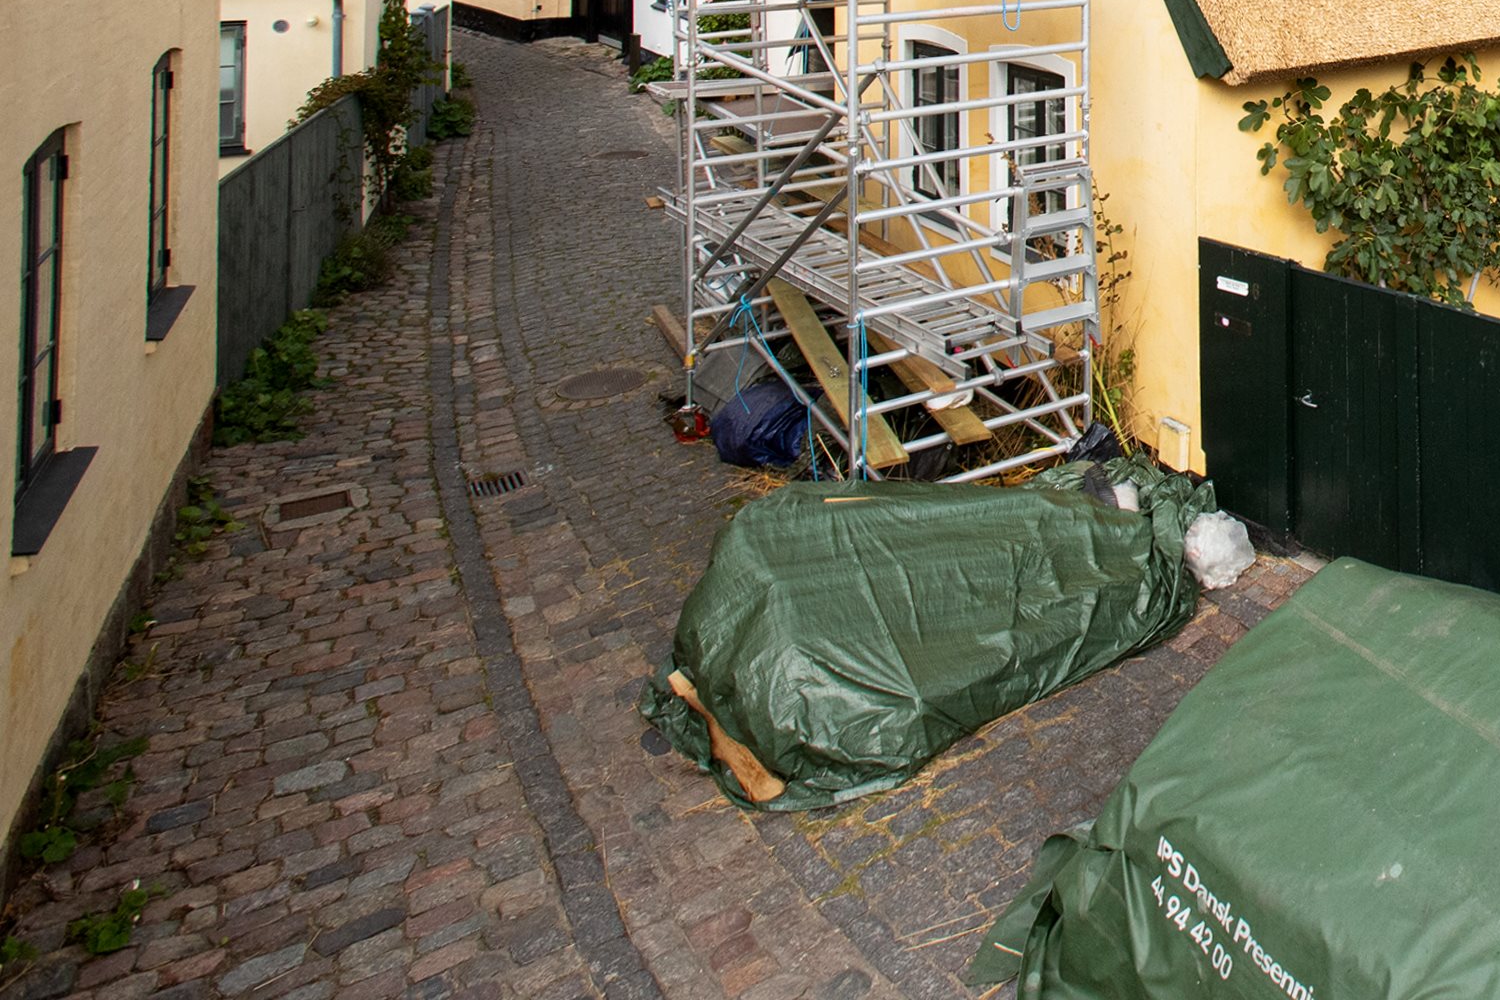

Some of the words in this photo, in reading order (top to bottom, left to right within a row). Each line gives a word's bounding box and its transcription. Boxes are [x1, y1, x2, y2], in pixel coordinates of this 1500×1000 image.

[1150, 875, 1165, 907] 44
[1165, 895, 1191, 931] 94
[1189, 921, 1213, 955] 42
[1211, 944, 1232, 980] 00
[1156, 835, 1184, 878] IPS
[1182, 862, 1234, 933] Dansk
[1233, 918, 1315, 1000] Presenni
